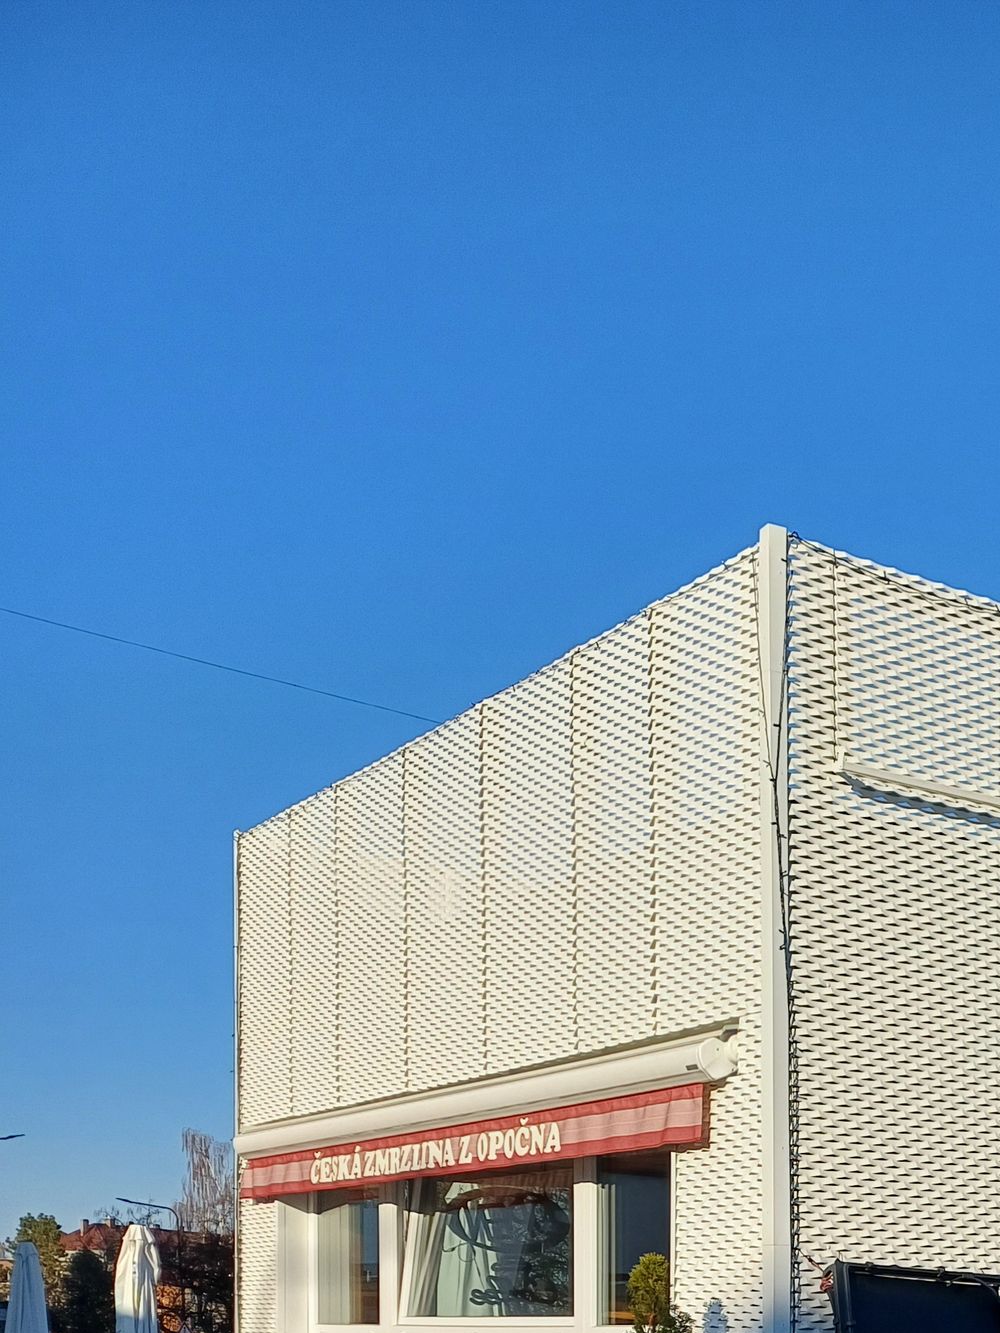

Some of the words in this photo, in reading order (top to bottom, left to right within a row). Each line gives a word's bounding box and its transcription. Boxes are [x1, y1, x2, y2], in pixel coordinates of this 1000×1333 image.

[310, 1146, 363, 1185] ČESKÁ
[363, 1138, 455, 1177] ZMRZLINA
[458, 1134, 473, 1165] Z
[477, 1117, 562, 1162] OPOČNA
